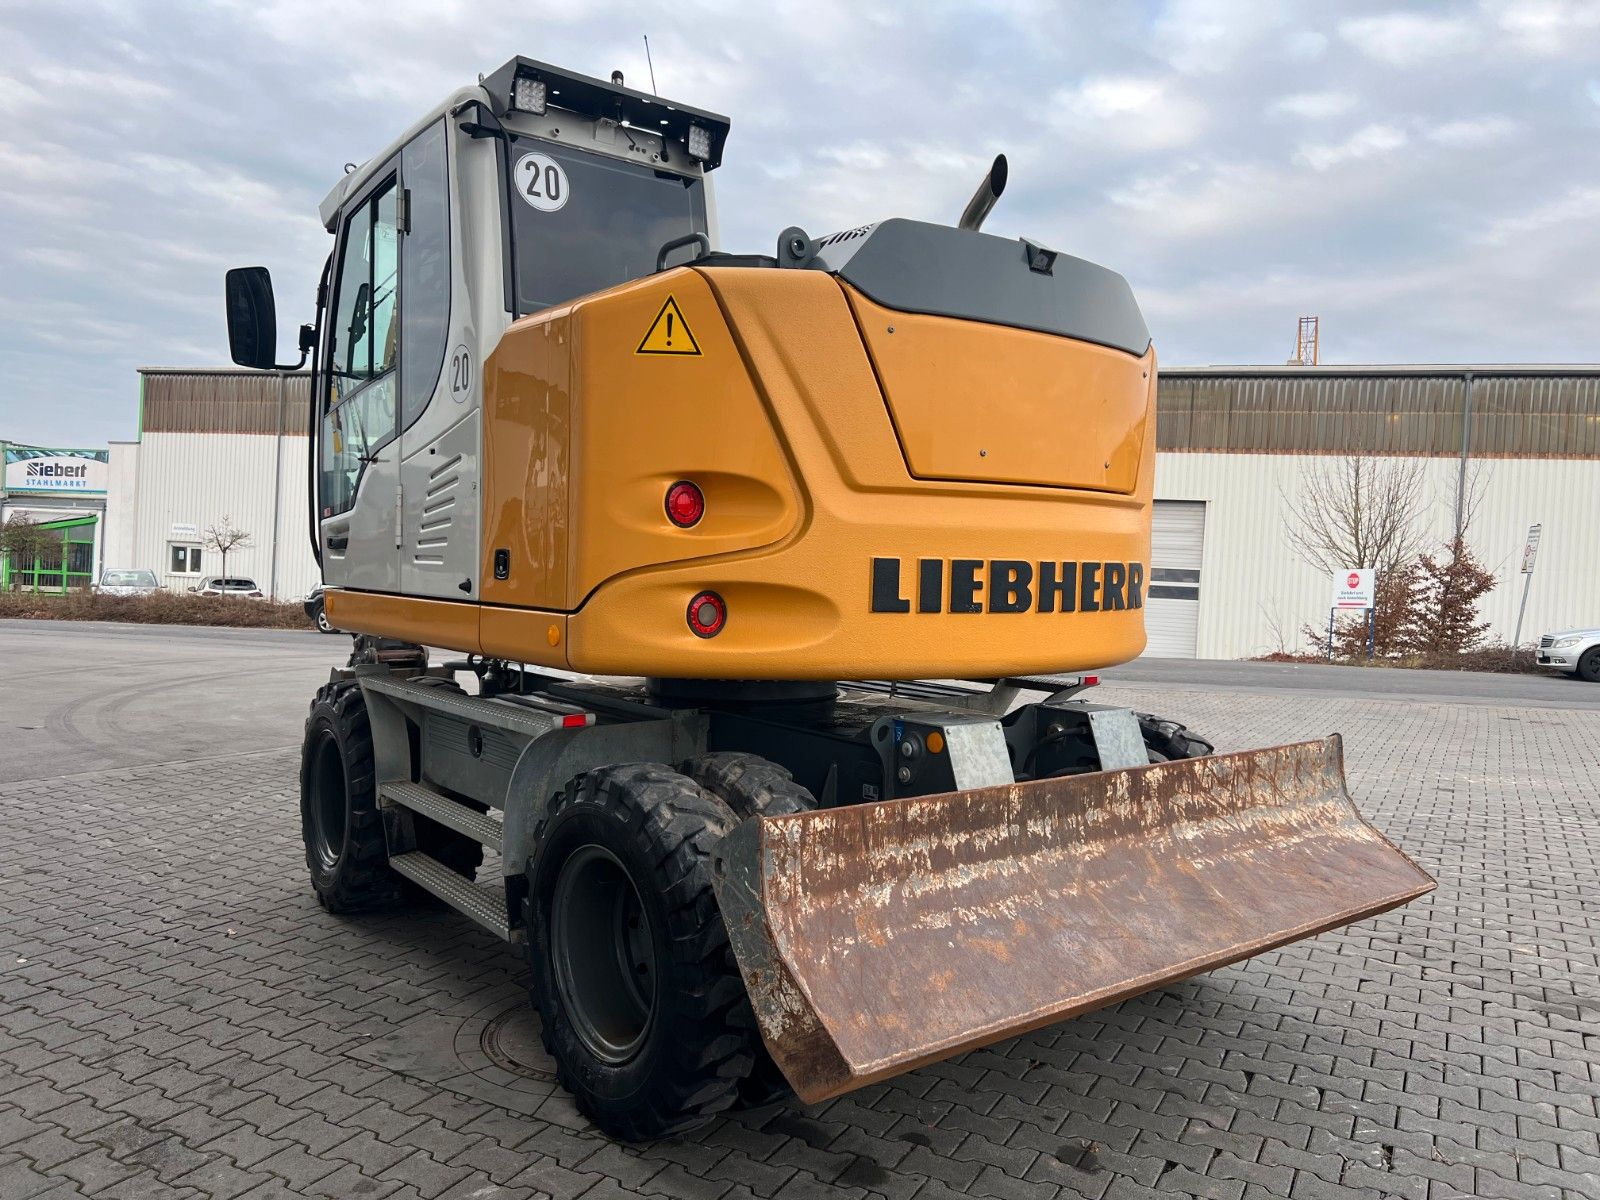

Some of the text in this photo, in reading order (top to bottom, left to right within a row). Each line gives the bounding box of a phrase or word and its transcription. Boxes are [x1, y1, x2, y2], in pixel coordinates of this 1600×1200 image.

[525, 160, 559, 201] 20
[453, 352, 469, 393] 20
[26, 479, 86, 487] STAHLMARKT
[27, 462, 87, 477] Siebert
[871, 557, 1143, 614] LIEBHERR
